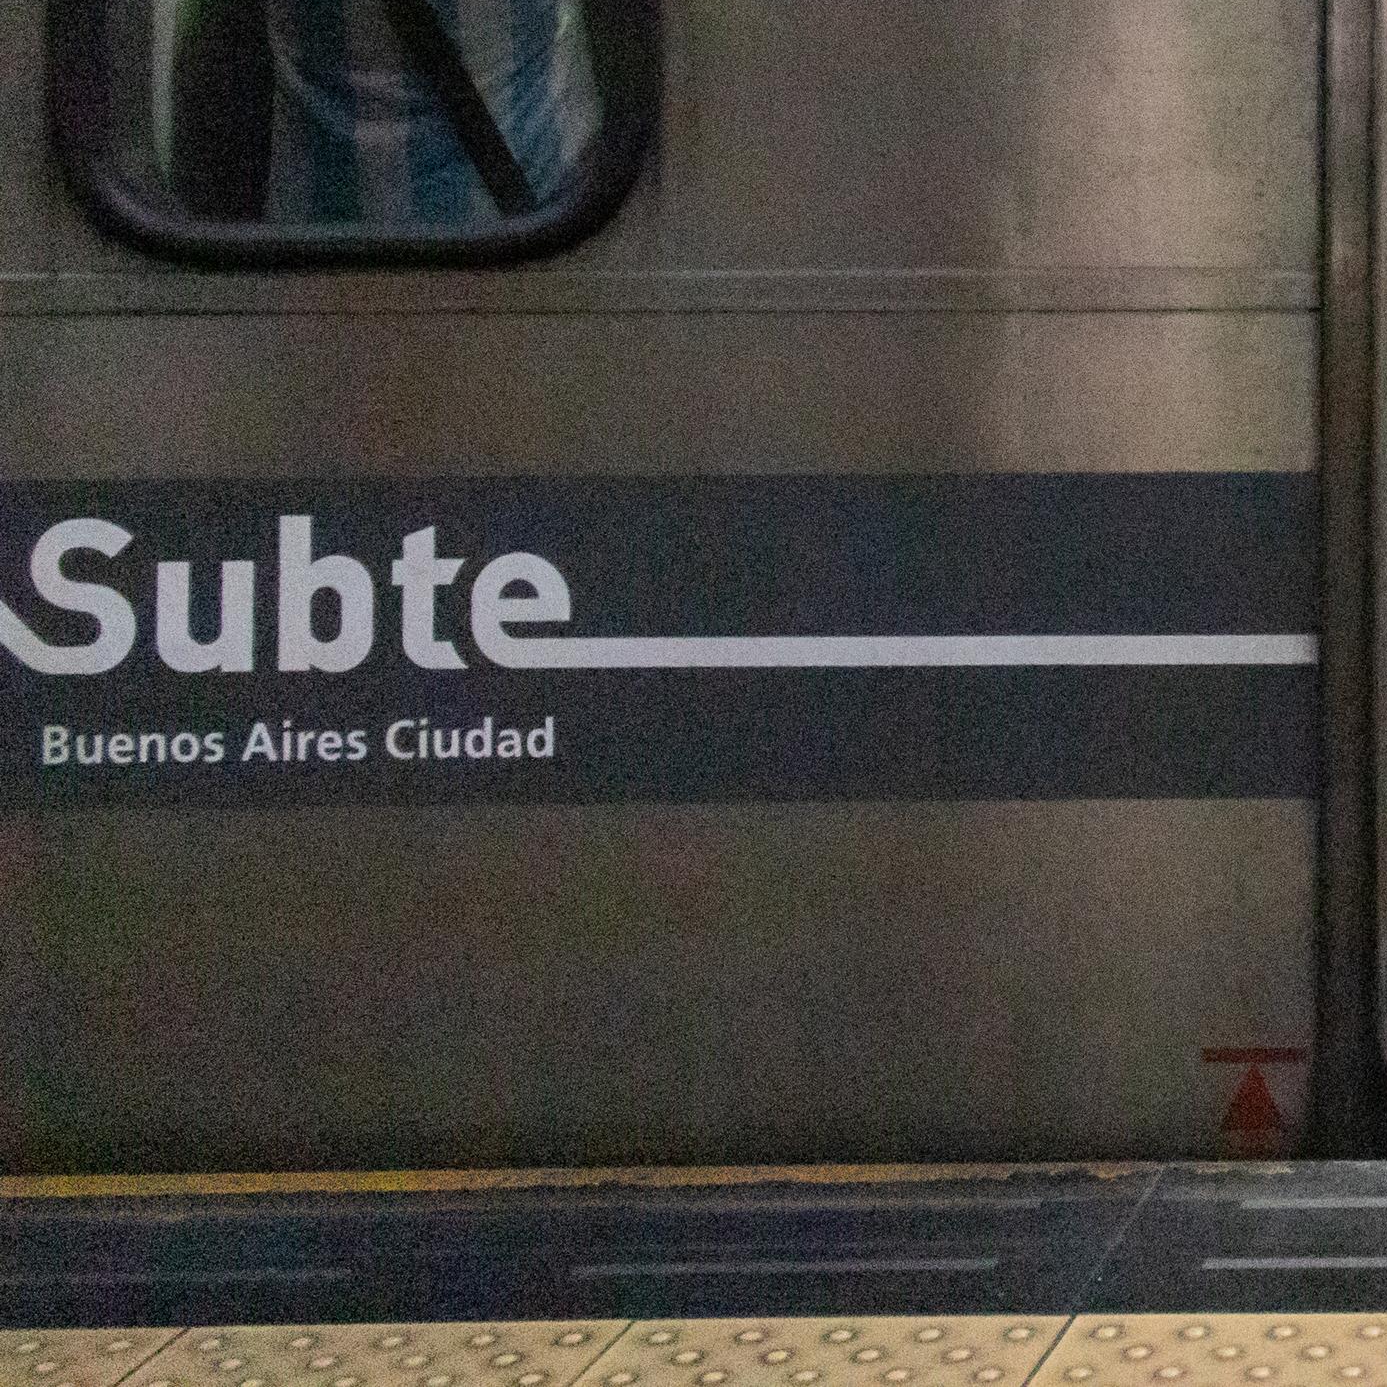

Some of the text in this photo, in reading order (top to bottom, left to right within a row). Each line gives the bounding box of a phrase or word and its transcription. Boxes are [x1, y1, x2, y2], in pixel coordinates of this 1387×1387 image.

[15, 514, 572, 676] Subte
[41, 716, 556, 766] Buenos Aires Ciudad
